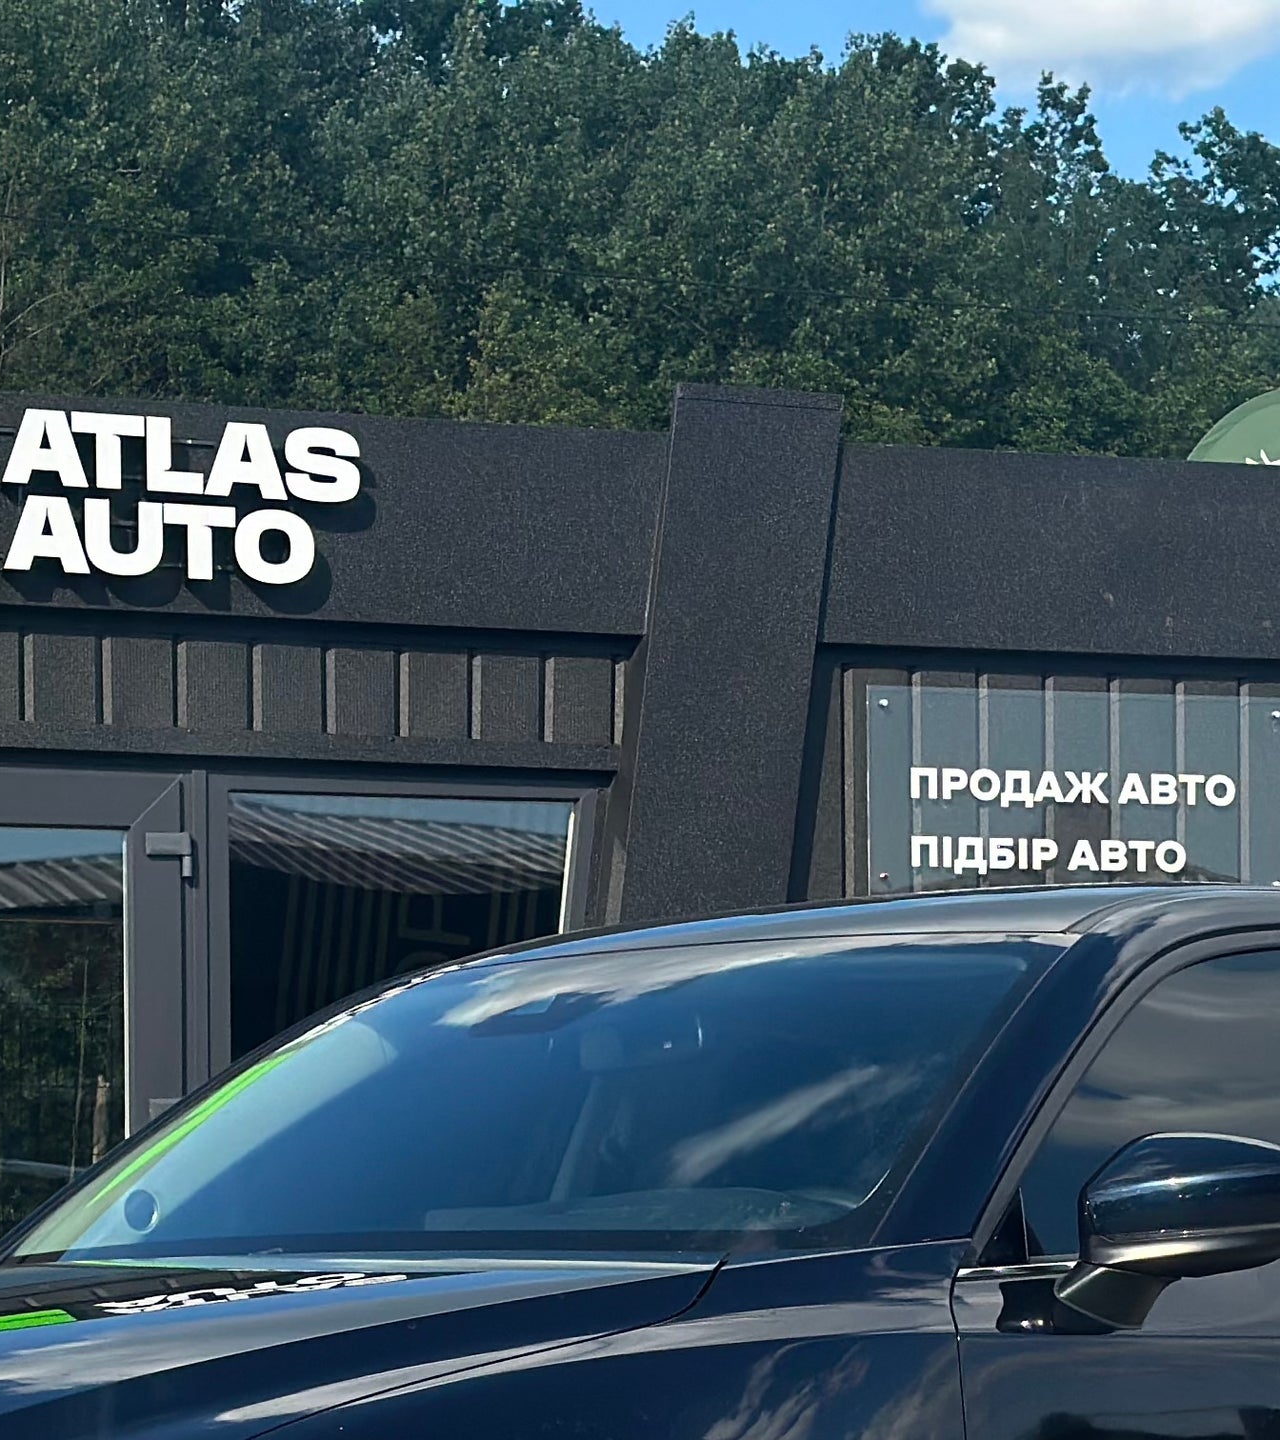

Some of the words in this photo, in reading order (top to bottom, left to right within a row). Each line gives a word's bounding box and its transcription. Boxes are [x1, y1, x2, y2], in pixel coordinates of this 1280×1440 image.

[2, 408, 361, 503] ATLAS
[3, 494, 315, 585] AUTO
[910, 766, 1110, 809] ПРОДАЖ
[1117, 772, 1236, 807] АВТО
[910, 835, 1059, 875] ПІДБІР
[1067, 839, 1187, 873] АВТО
